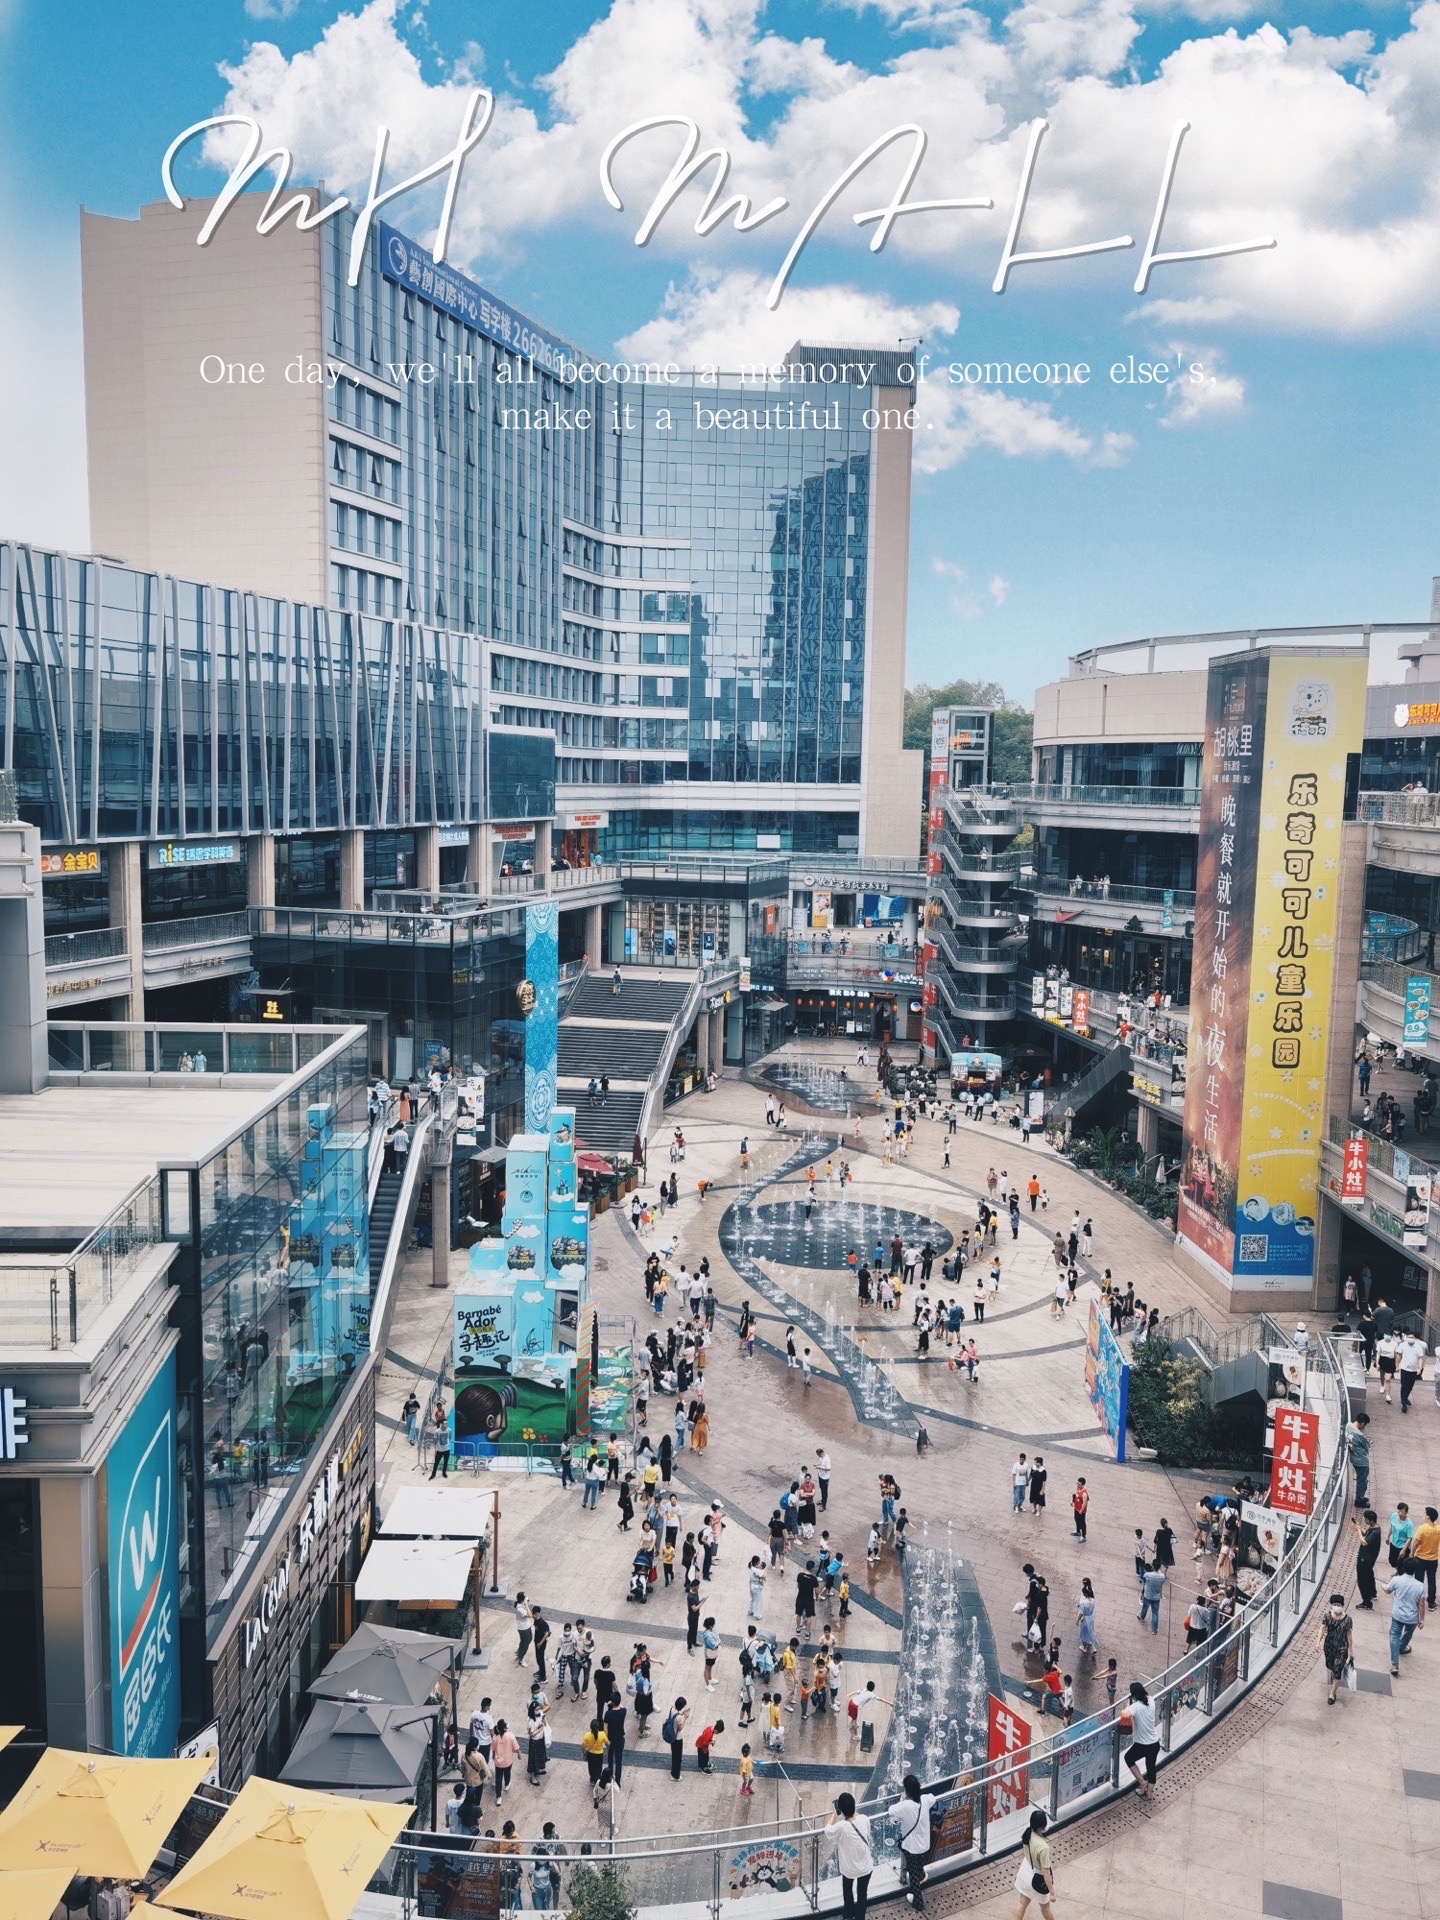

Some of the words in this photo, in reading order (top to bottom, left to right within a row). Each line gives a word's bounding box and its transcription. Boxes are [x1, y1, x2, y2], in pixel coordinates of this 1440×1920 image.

[408, 258, 478, 321] 藝創國際中心
[480, 297, 512, 344] 写字楼
[1213, 724, 1253, 758] 胡桃里
[63, 851, 98, 871] 金宝贝
[1271, 772, 1319, 1069] 乐奇可可儿童乐园
[1202, 794, 1237, 1146] 晚餐就开始的夜生活
[1076, 993, 1087, 1018] 牛小灶
[1346, 1142, 1363, 1186] 牛小灶
[457, 1304, 502, 1321] Barnabé
[463, 1316, 497, 1331] Ador
[459, 1330, 510, 1352] 寻趣记
[1278, 1414, 1310, 1494] 牛小灶
[1277, 1490, 1307, 1506] 牛杂煲
[123, 1590, 171, 1755] 屈臣氏
[467, 1862, 496, 1875] 越野
